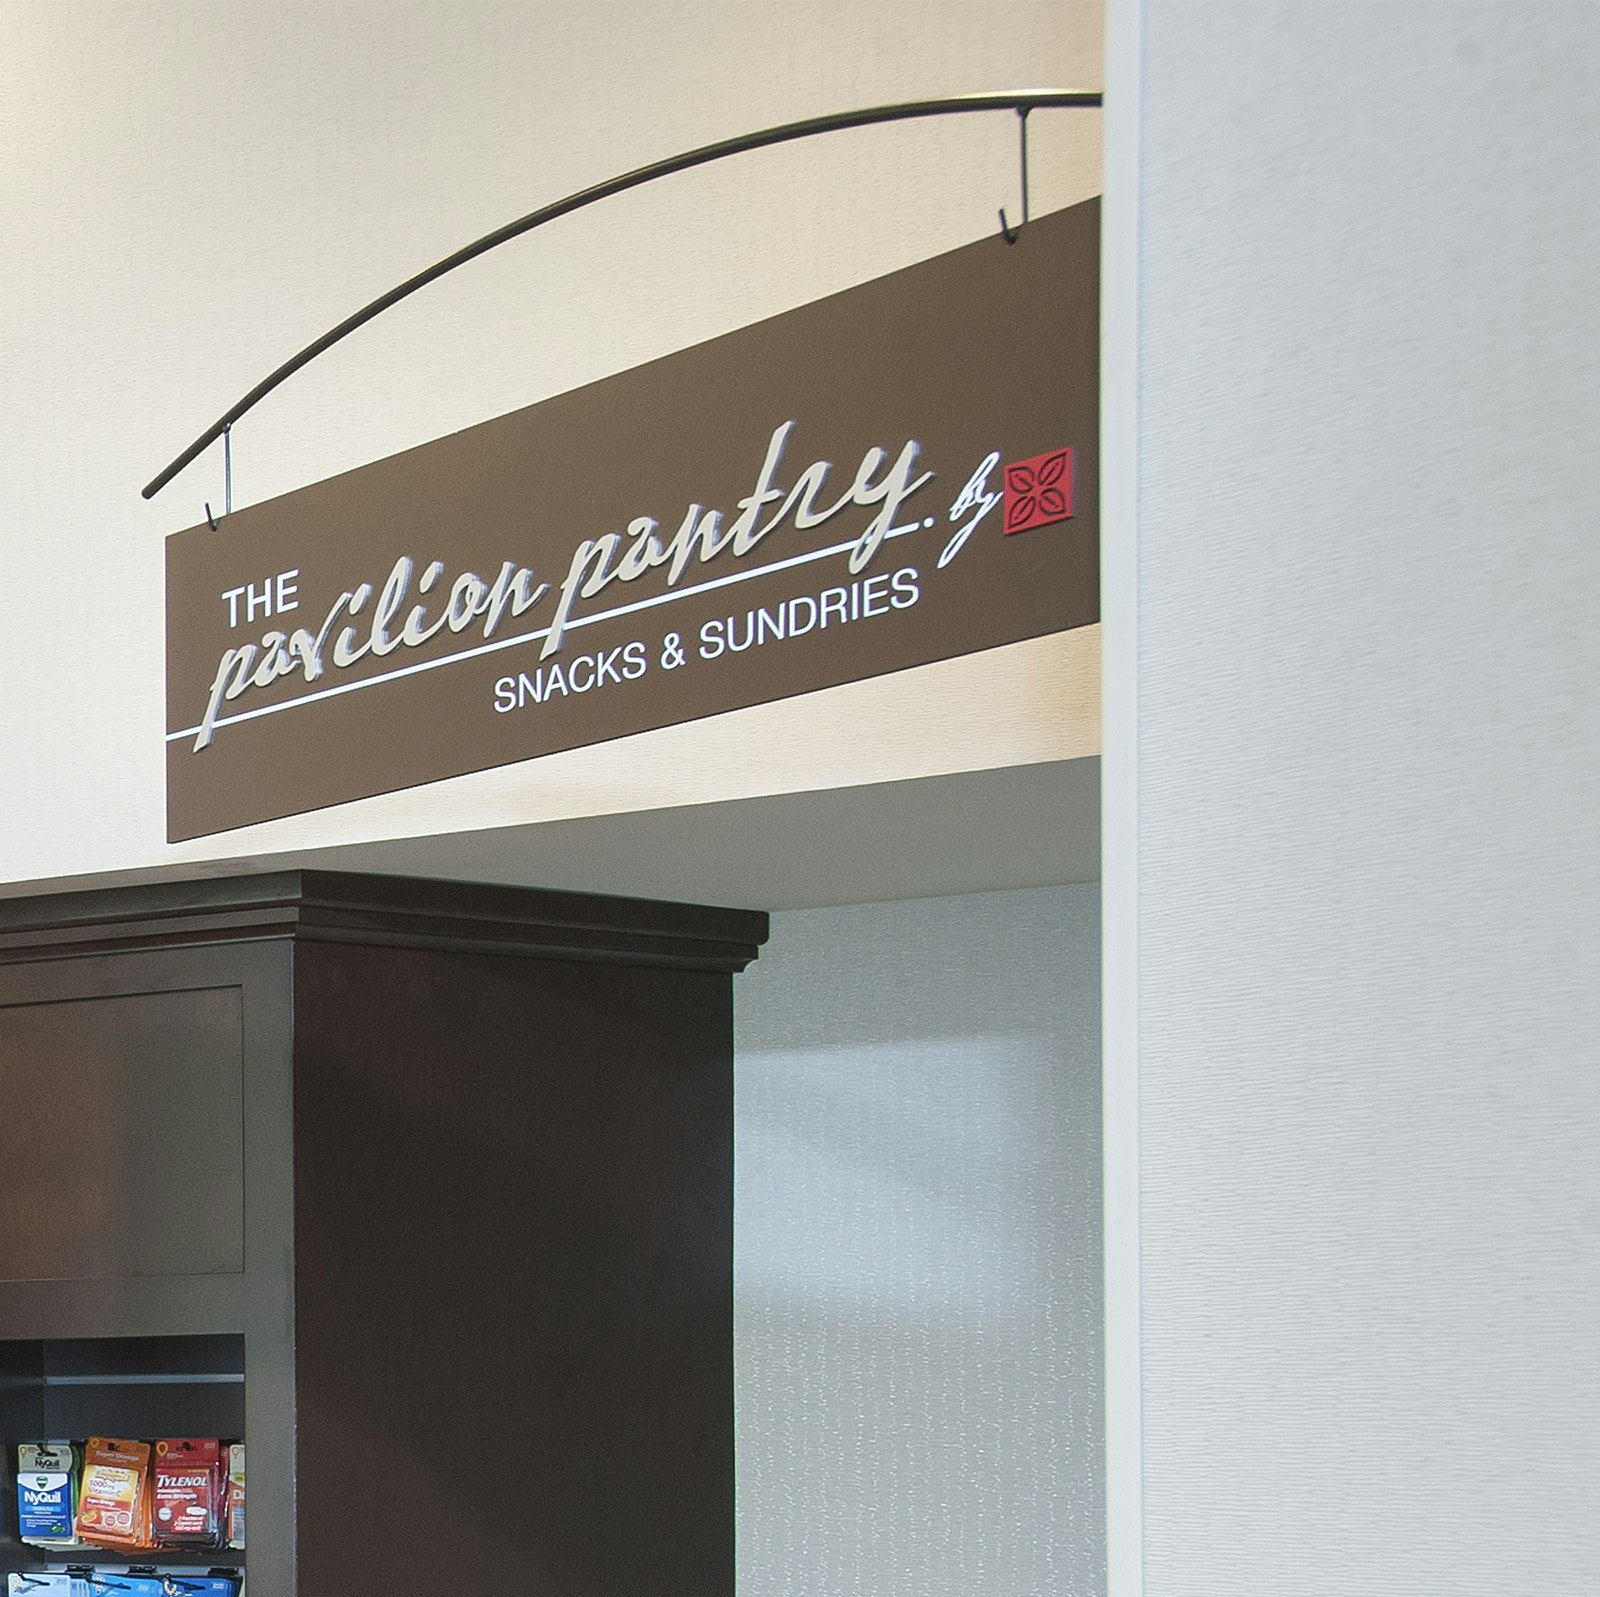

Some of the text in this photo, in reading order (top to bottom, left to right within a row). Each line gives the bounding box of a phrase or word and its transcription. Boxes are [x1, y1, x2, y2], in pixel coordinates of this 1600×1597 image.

[220, 569, 300, 629] THE
[193, 556, 546, 752] pavilion
[493, 566, 921, 716] SNACKS & SUNDRIES
[34, 1459, 60, 1470] NyQuil
[157, 1475, 208, 1488] TYLENOL
[24, 1491, 61, 1506] NyQuil
